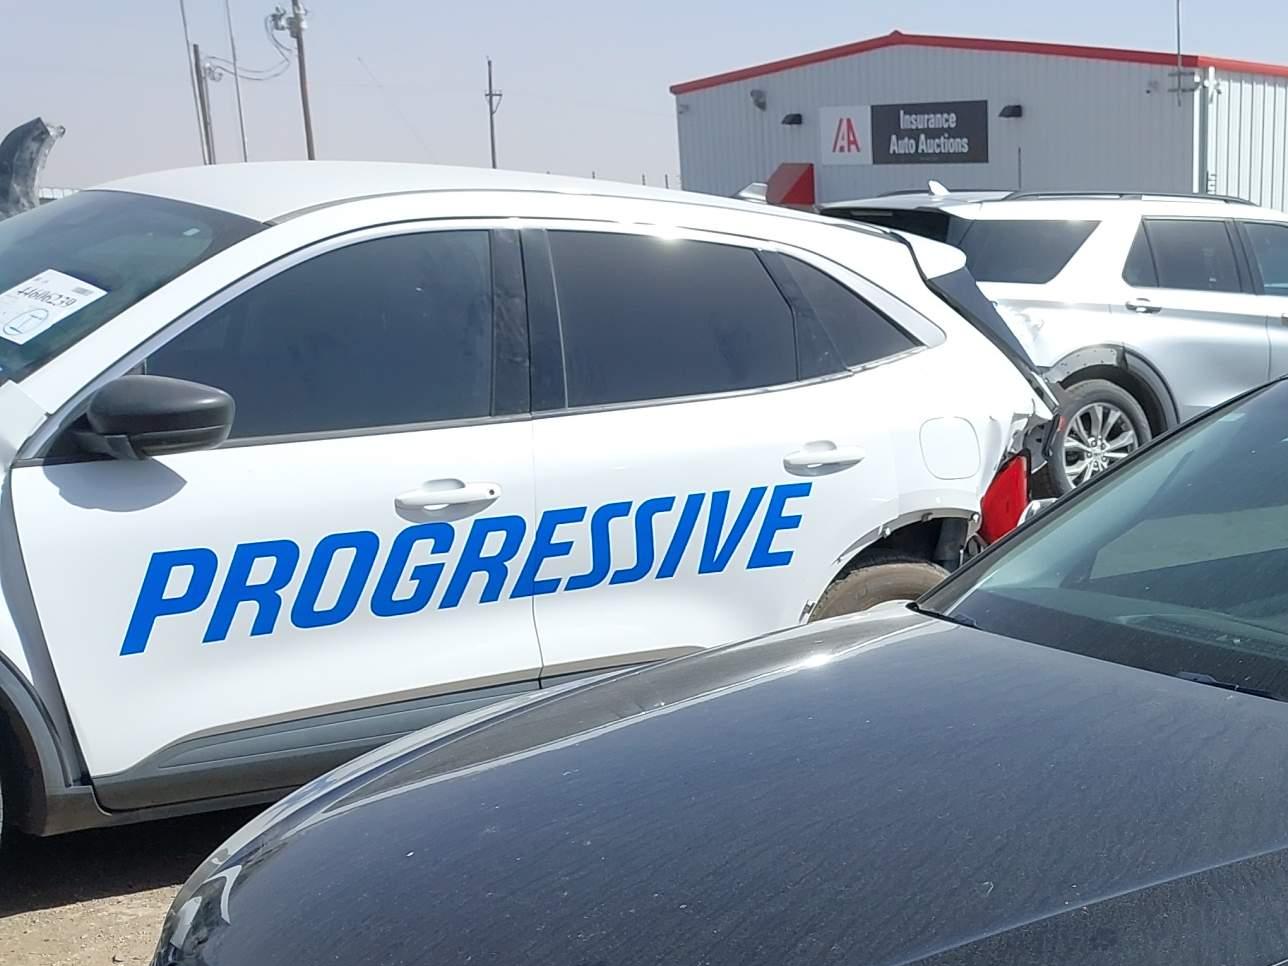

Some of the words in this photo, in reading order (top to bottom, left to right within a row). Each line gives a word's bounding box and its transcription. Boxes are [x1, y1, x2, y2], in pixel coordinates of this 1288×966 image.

[900, 109, 957, 130] Insurance
[889, 134, 917, 155] Auto
[917, 132, 969, 154] Auctions
[120, 481, 813, 657] PROGRESSIVE
